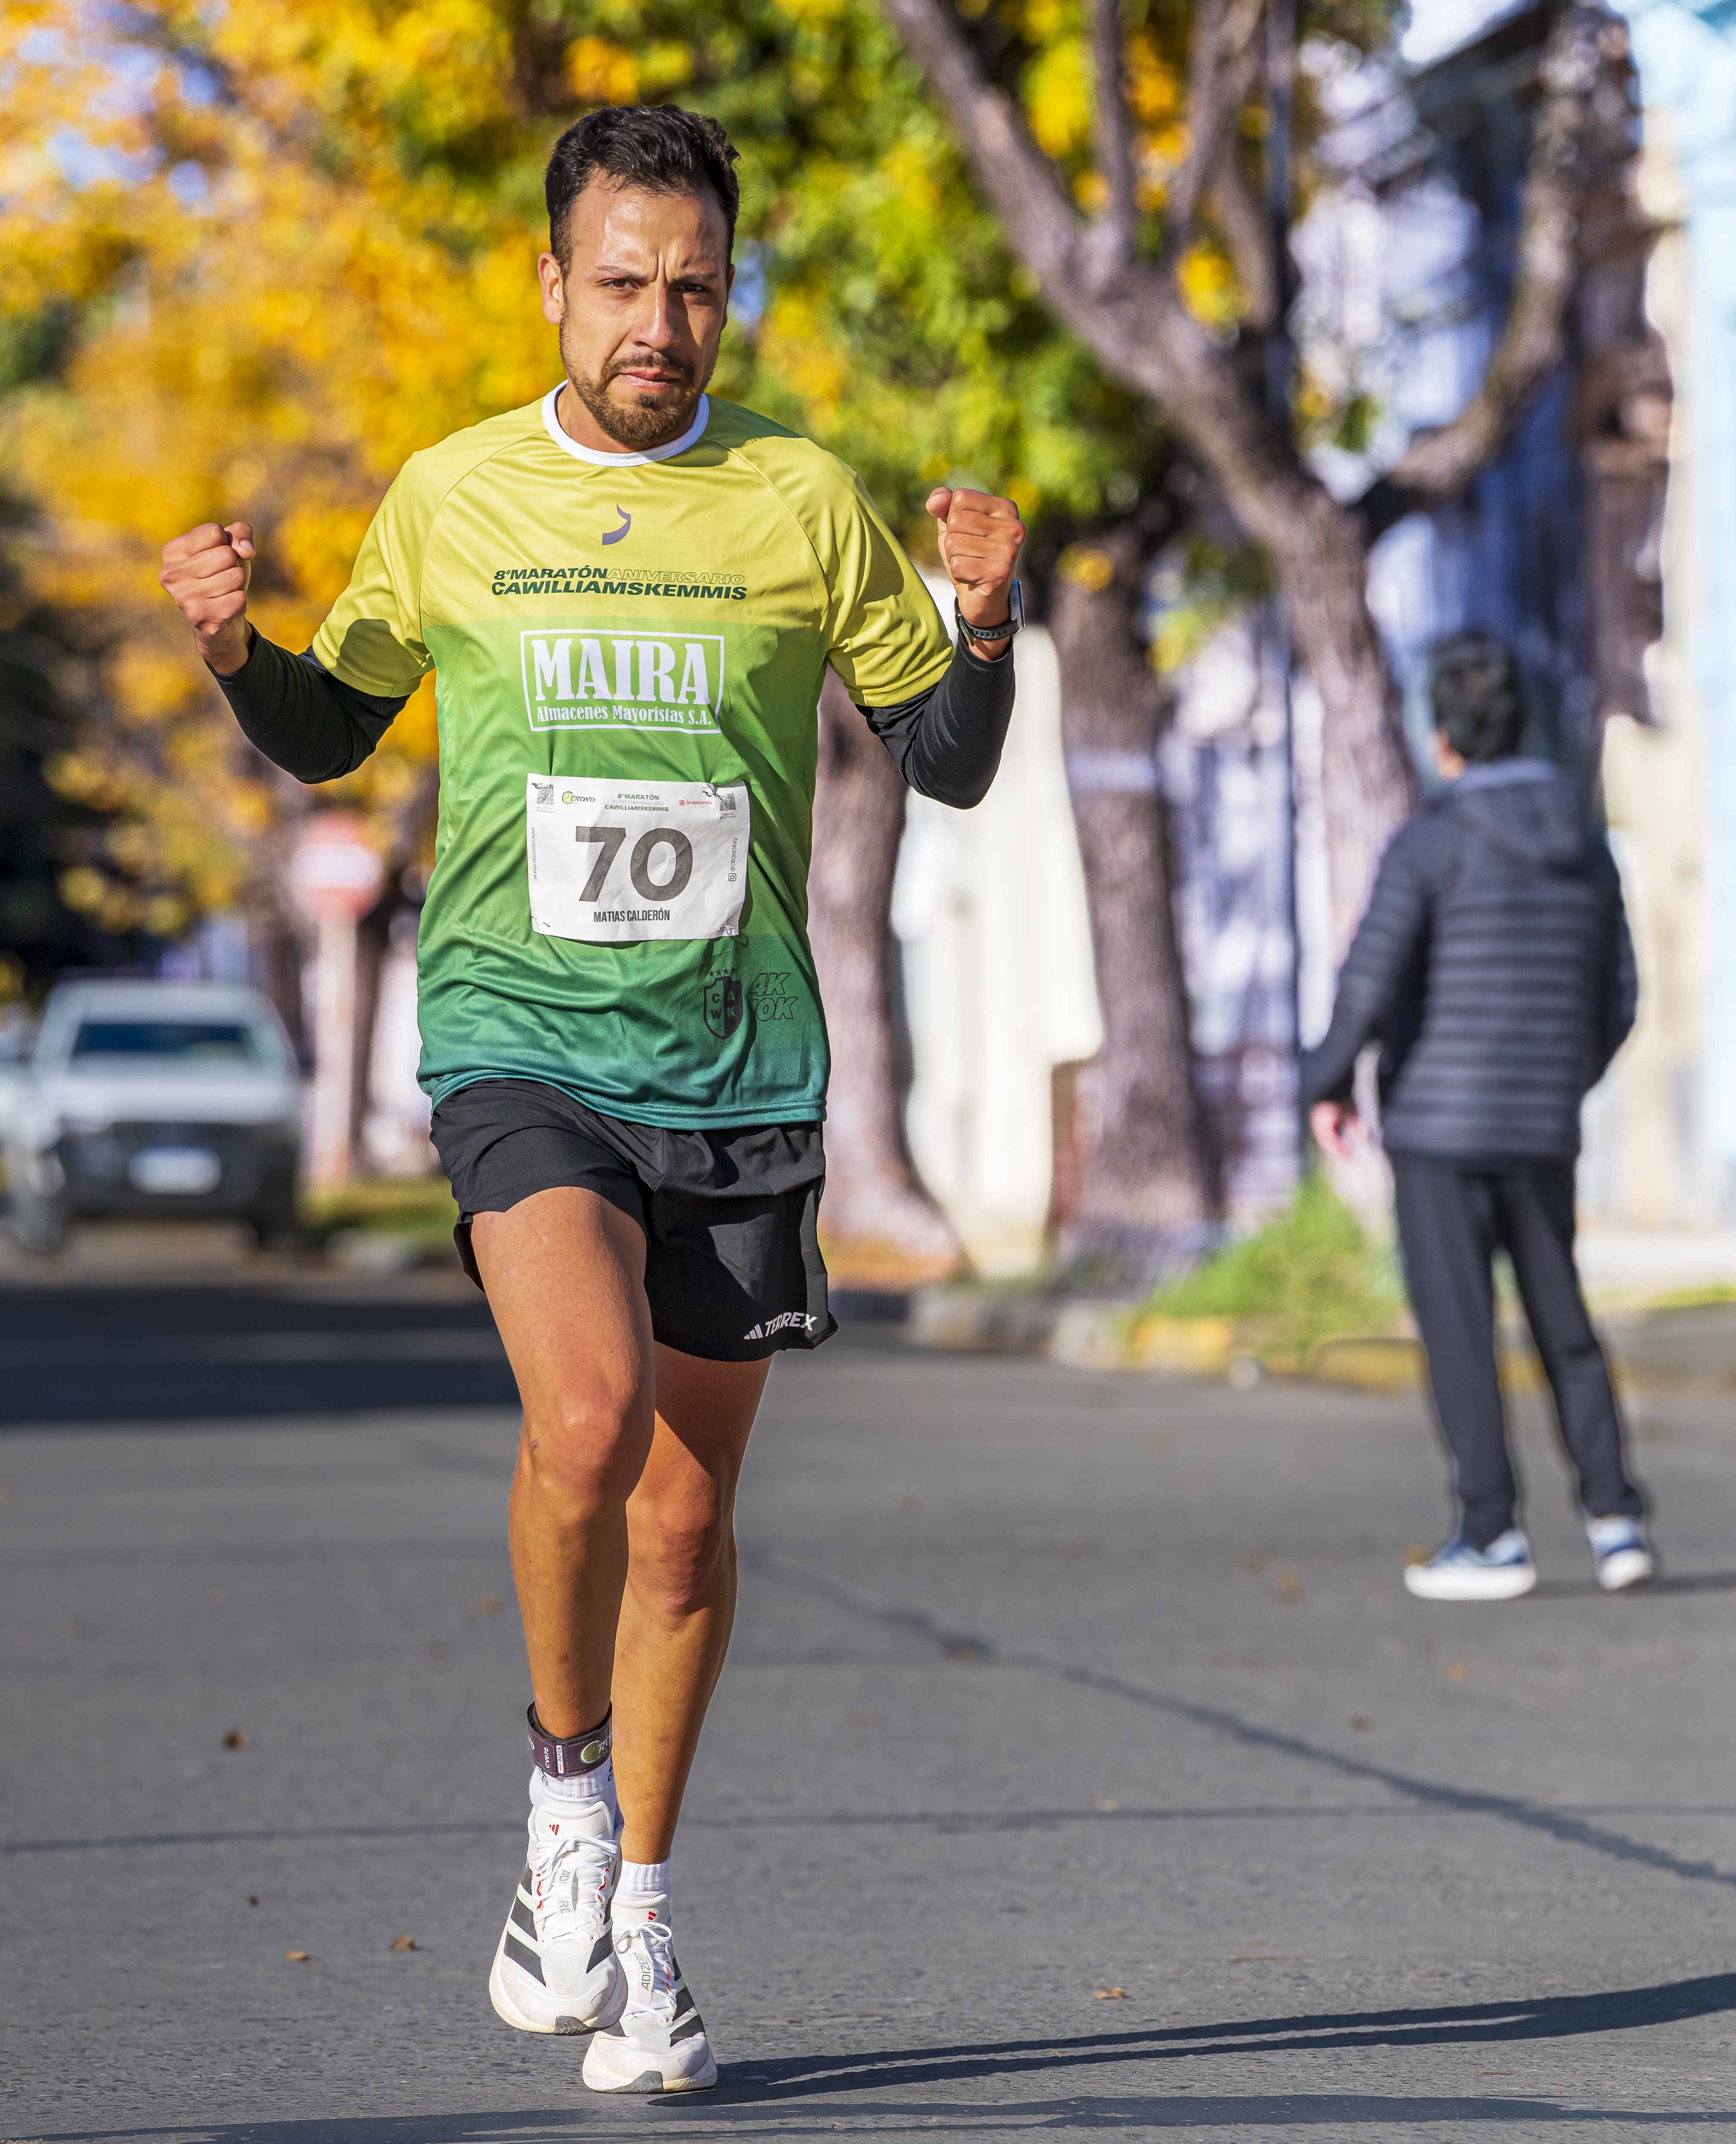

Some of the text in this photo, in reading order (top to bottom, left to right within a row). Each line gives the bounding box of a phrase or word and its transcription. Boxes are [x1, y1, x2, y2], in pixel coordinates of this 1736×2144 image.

[607, 569, 745, 585] ANIVERSARIO
[492, 581, 747, 600] CAWILLIAMSKEMMIS
[531, 638, 710, 705] MAIRA
[537, 705, 712, 726] Almacenes Mayoristas S.A.
[575, 826, 693, 902] 70
[594, 908, 670, 922] MATIAS CALDERÓN
[749, 972, 790, 997] 4K
[765, 1312, 818, 1337] TERREX
